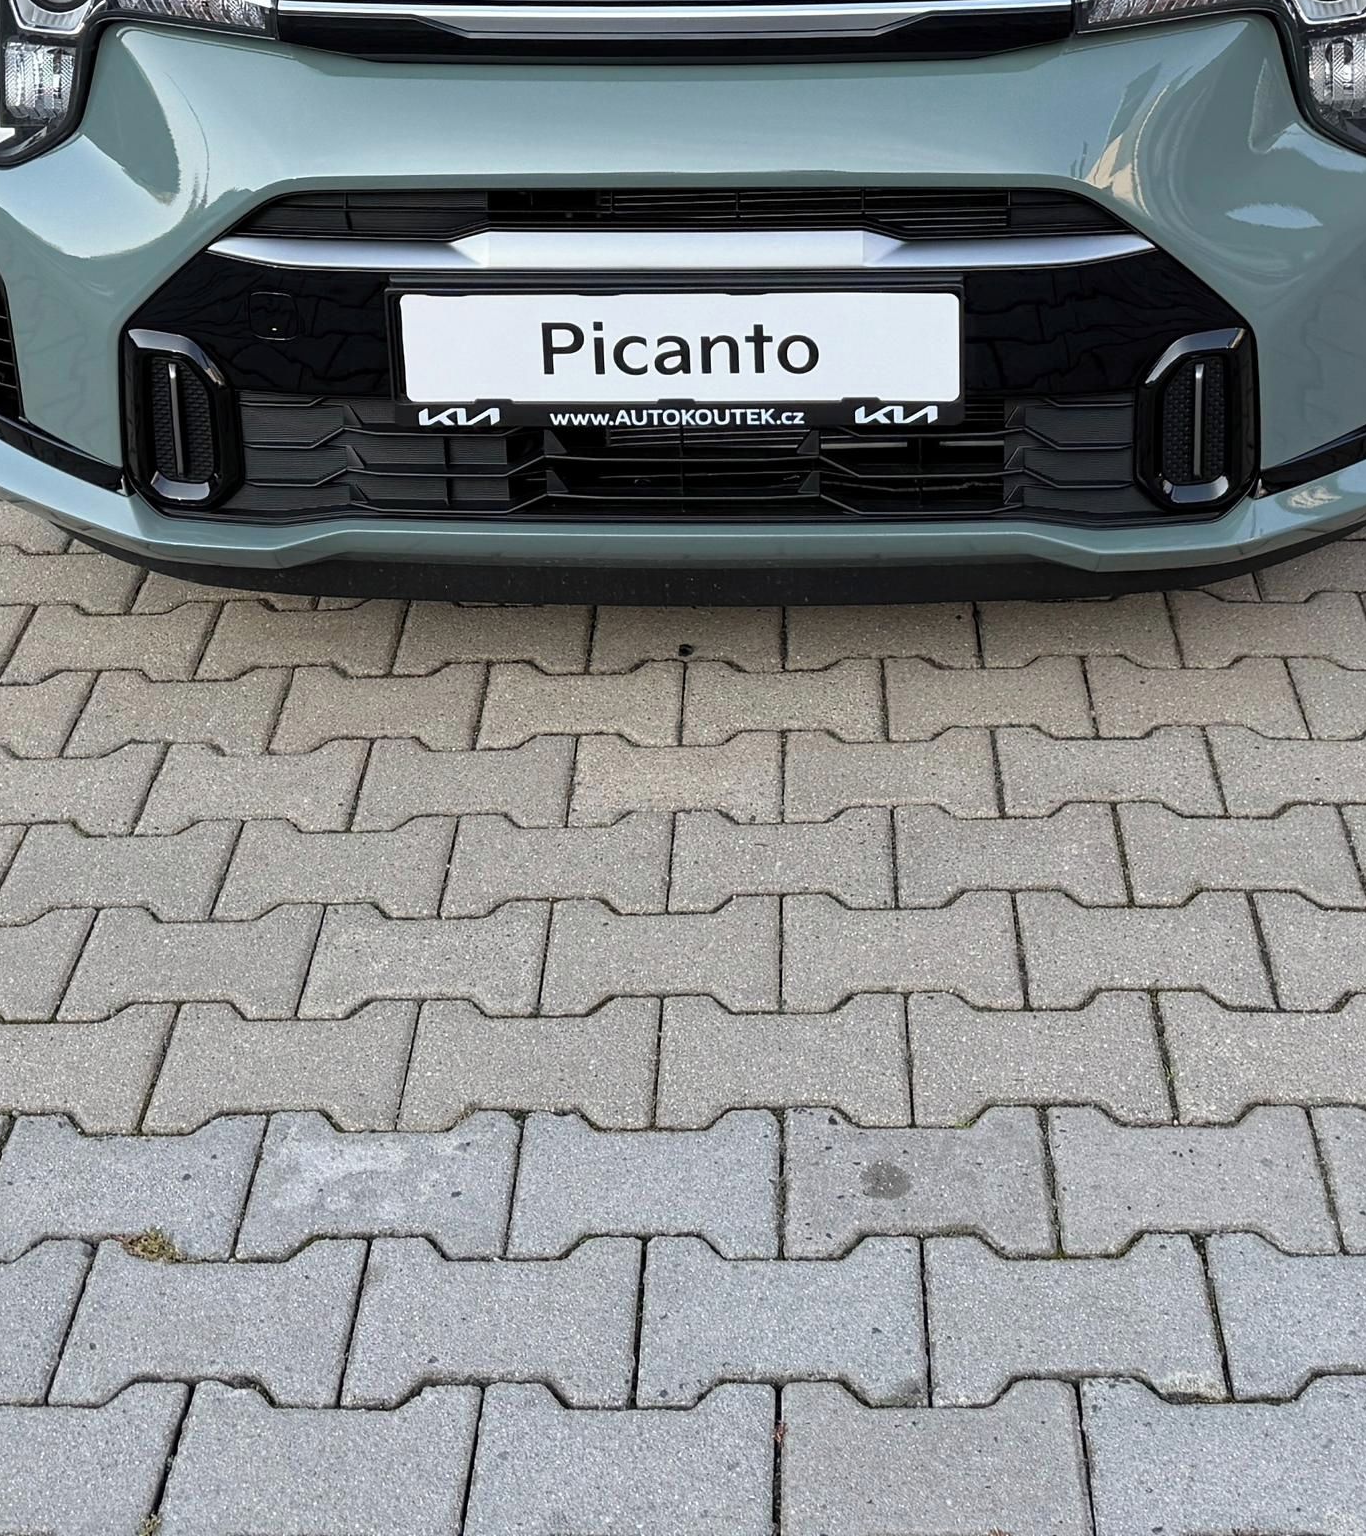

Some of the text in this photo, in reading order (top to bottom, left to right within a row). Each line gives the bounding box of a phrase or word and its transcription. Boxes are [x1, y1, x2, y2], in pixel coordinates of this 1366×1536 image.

[539, 320, 821, 376] Picanto
[417, 405, 939, 427] KIA www.AUTOKOUTEK.cz KIA
